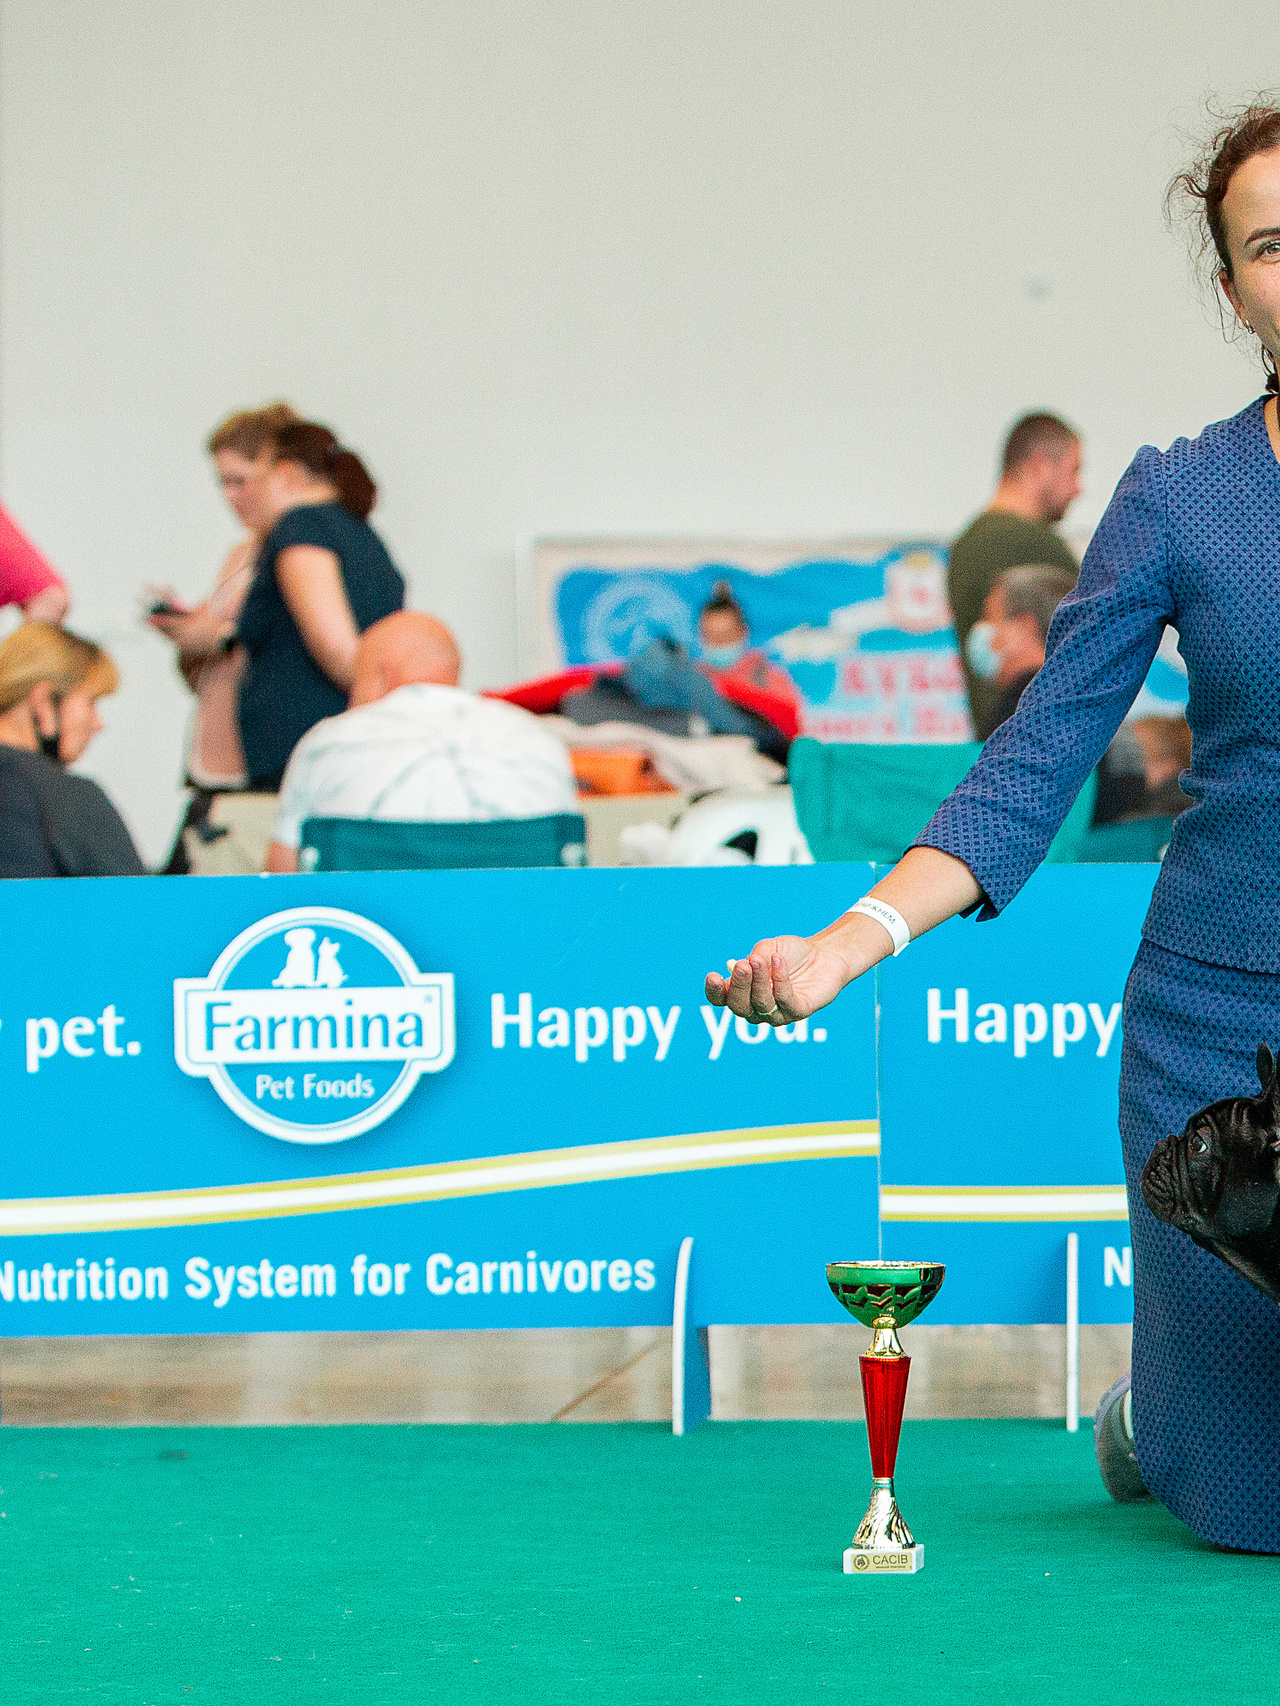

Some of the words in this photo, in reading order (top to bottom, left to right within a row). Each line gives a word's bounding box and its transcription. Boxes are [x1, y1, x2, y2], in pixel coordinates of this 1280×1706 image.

[25, 1004, 141, 1073] pet.
[204, 998, 424, 1051] Farmina
[491, 992, 681, 1063] Happy
[927, 987, 1123, 1058] Happy
[255, 1074, 295, 1100] Pet
[303, 1073, 375, 1100] Foods
[184, 1256, 336, 1308] System
[350, 1254, 411, 1296] for
[426, 1250, 656, 1295] Carnivores
[872, 1554, 909, 1565] CACIB
